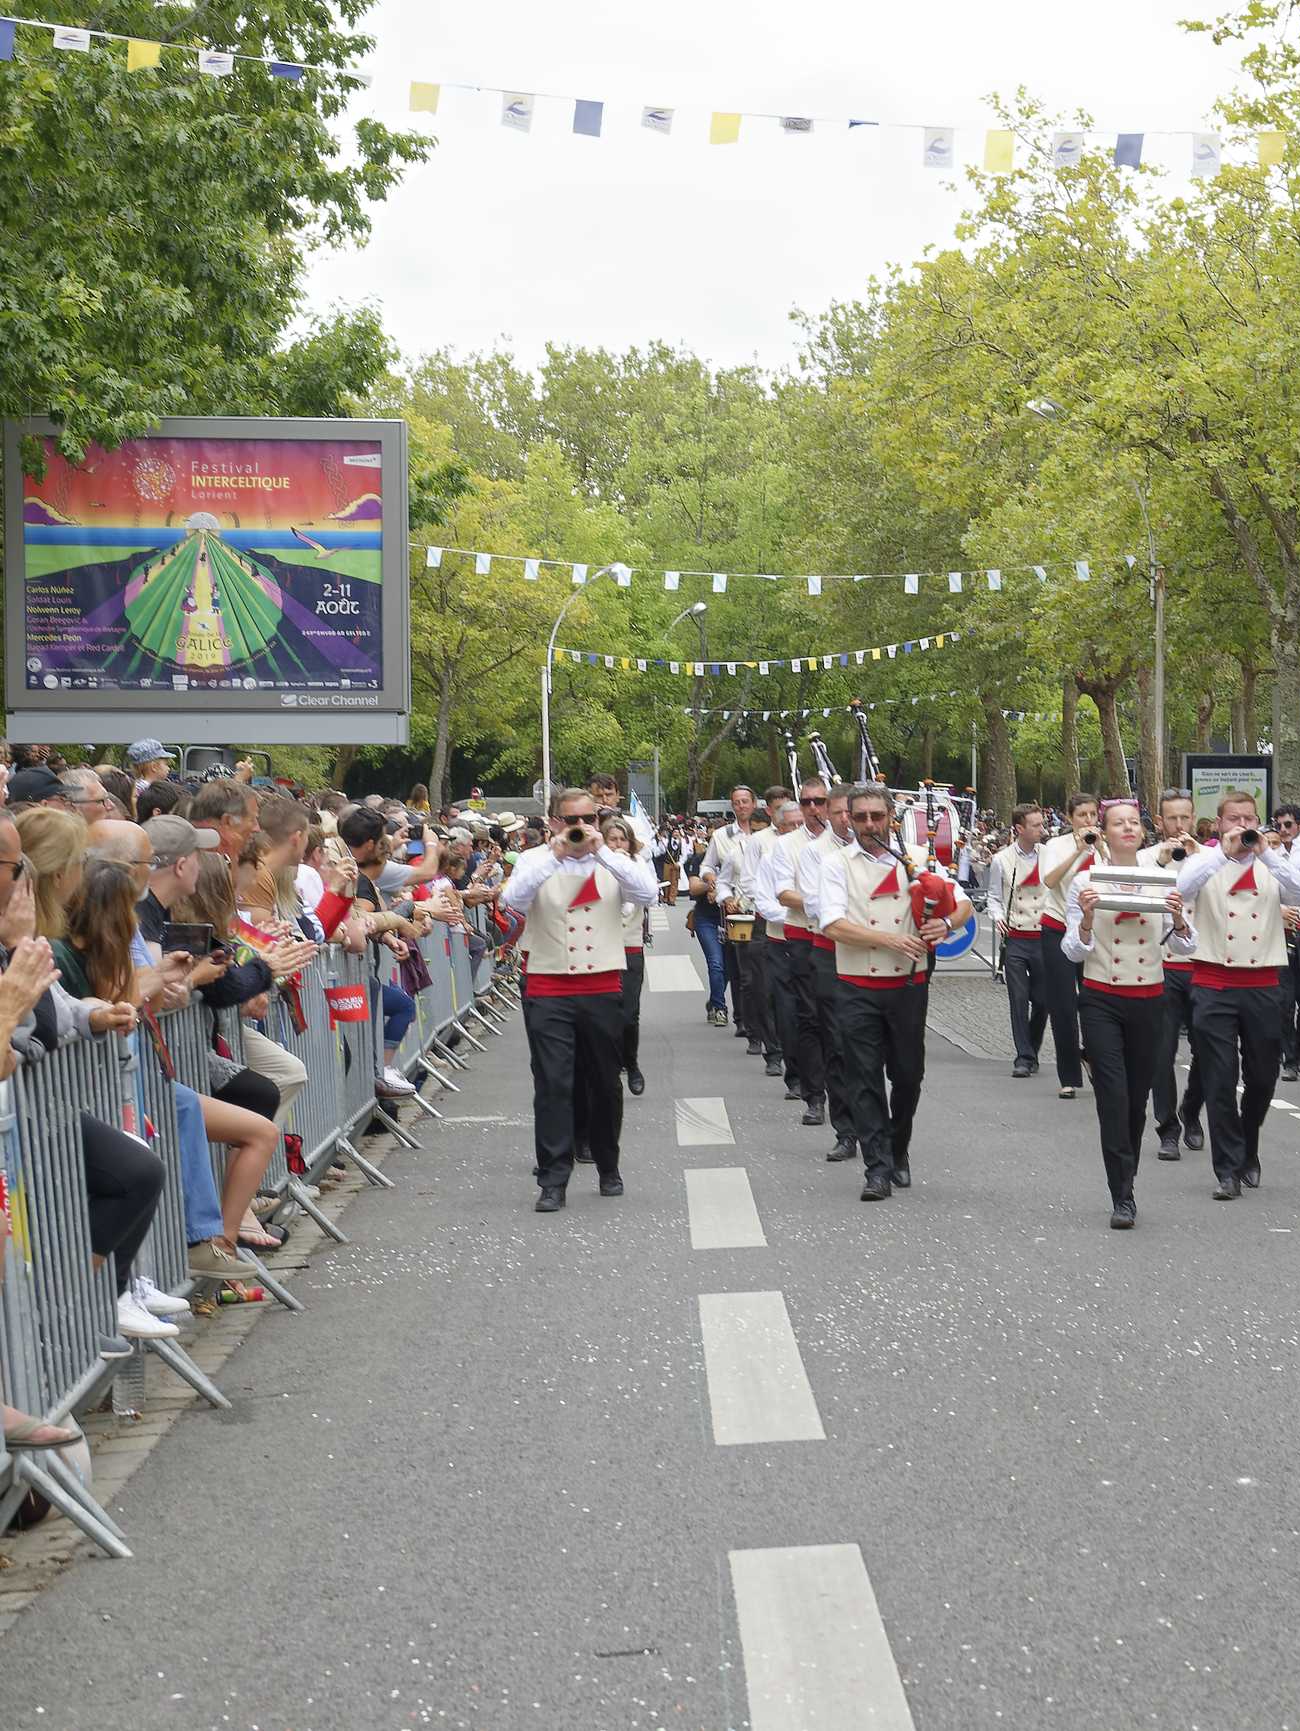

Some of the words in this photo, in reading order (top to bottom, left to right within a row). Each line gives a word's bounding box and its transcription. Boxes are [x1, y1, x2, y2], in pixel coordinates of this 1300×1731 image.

[192, 461, 259, 474] Festival
[191, 475, 290, 491] INTERCELTIQUE
[191, 490, 237, 499] Lorient
[323, 583, 351, 597] 2-11
[298, 695, 328, 705] Clear
[331, 695, 378, 705] Channel
